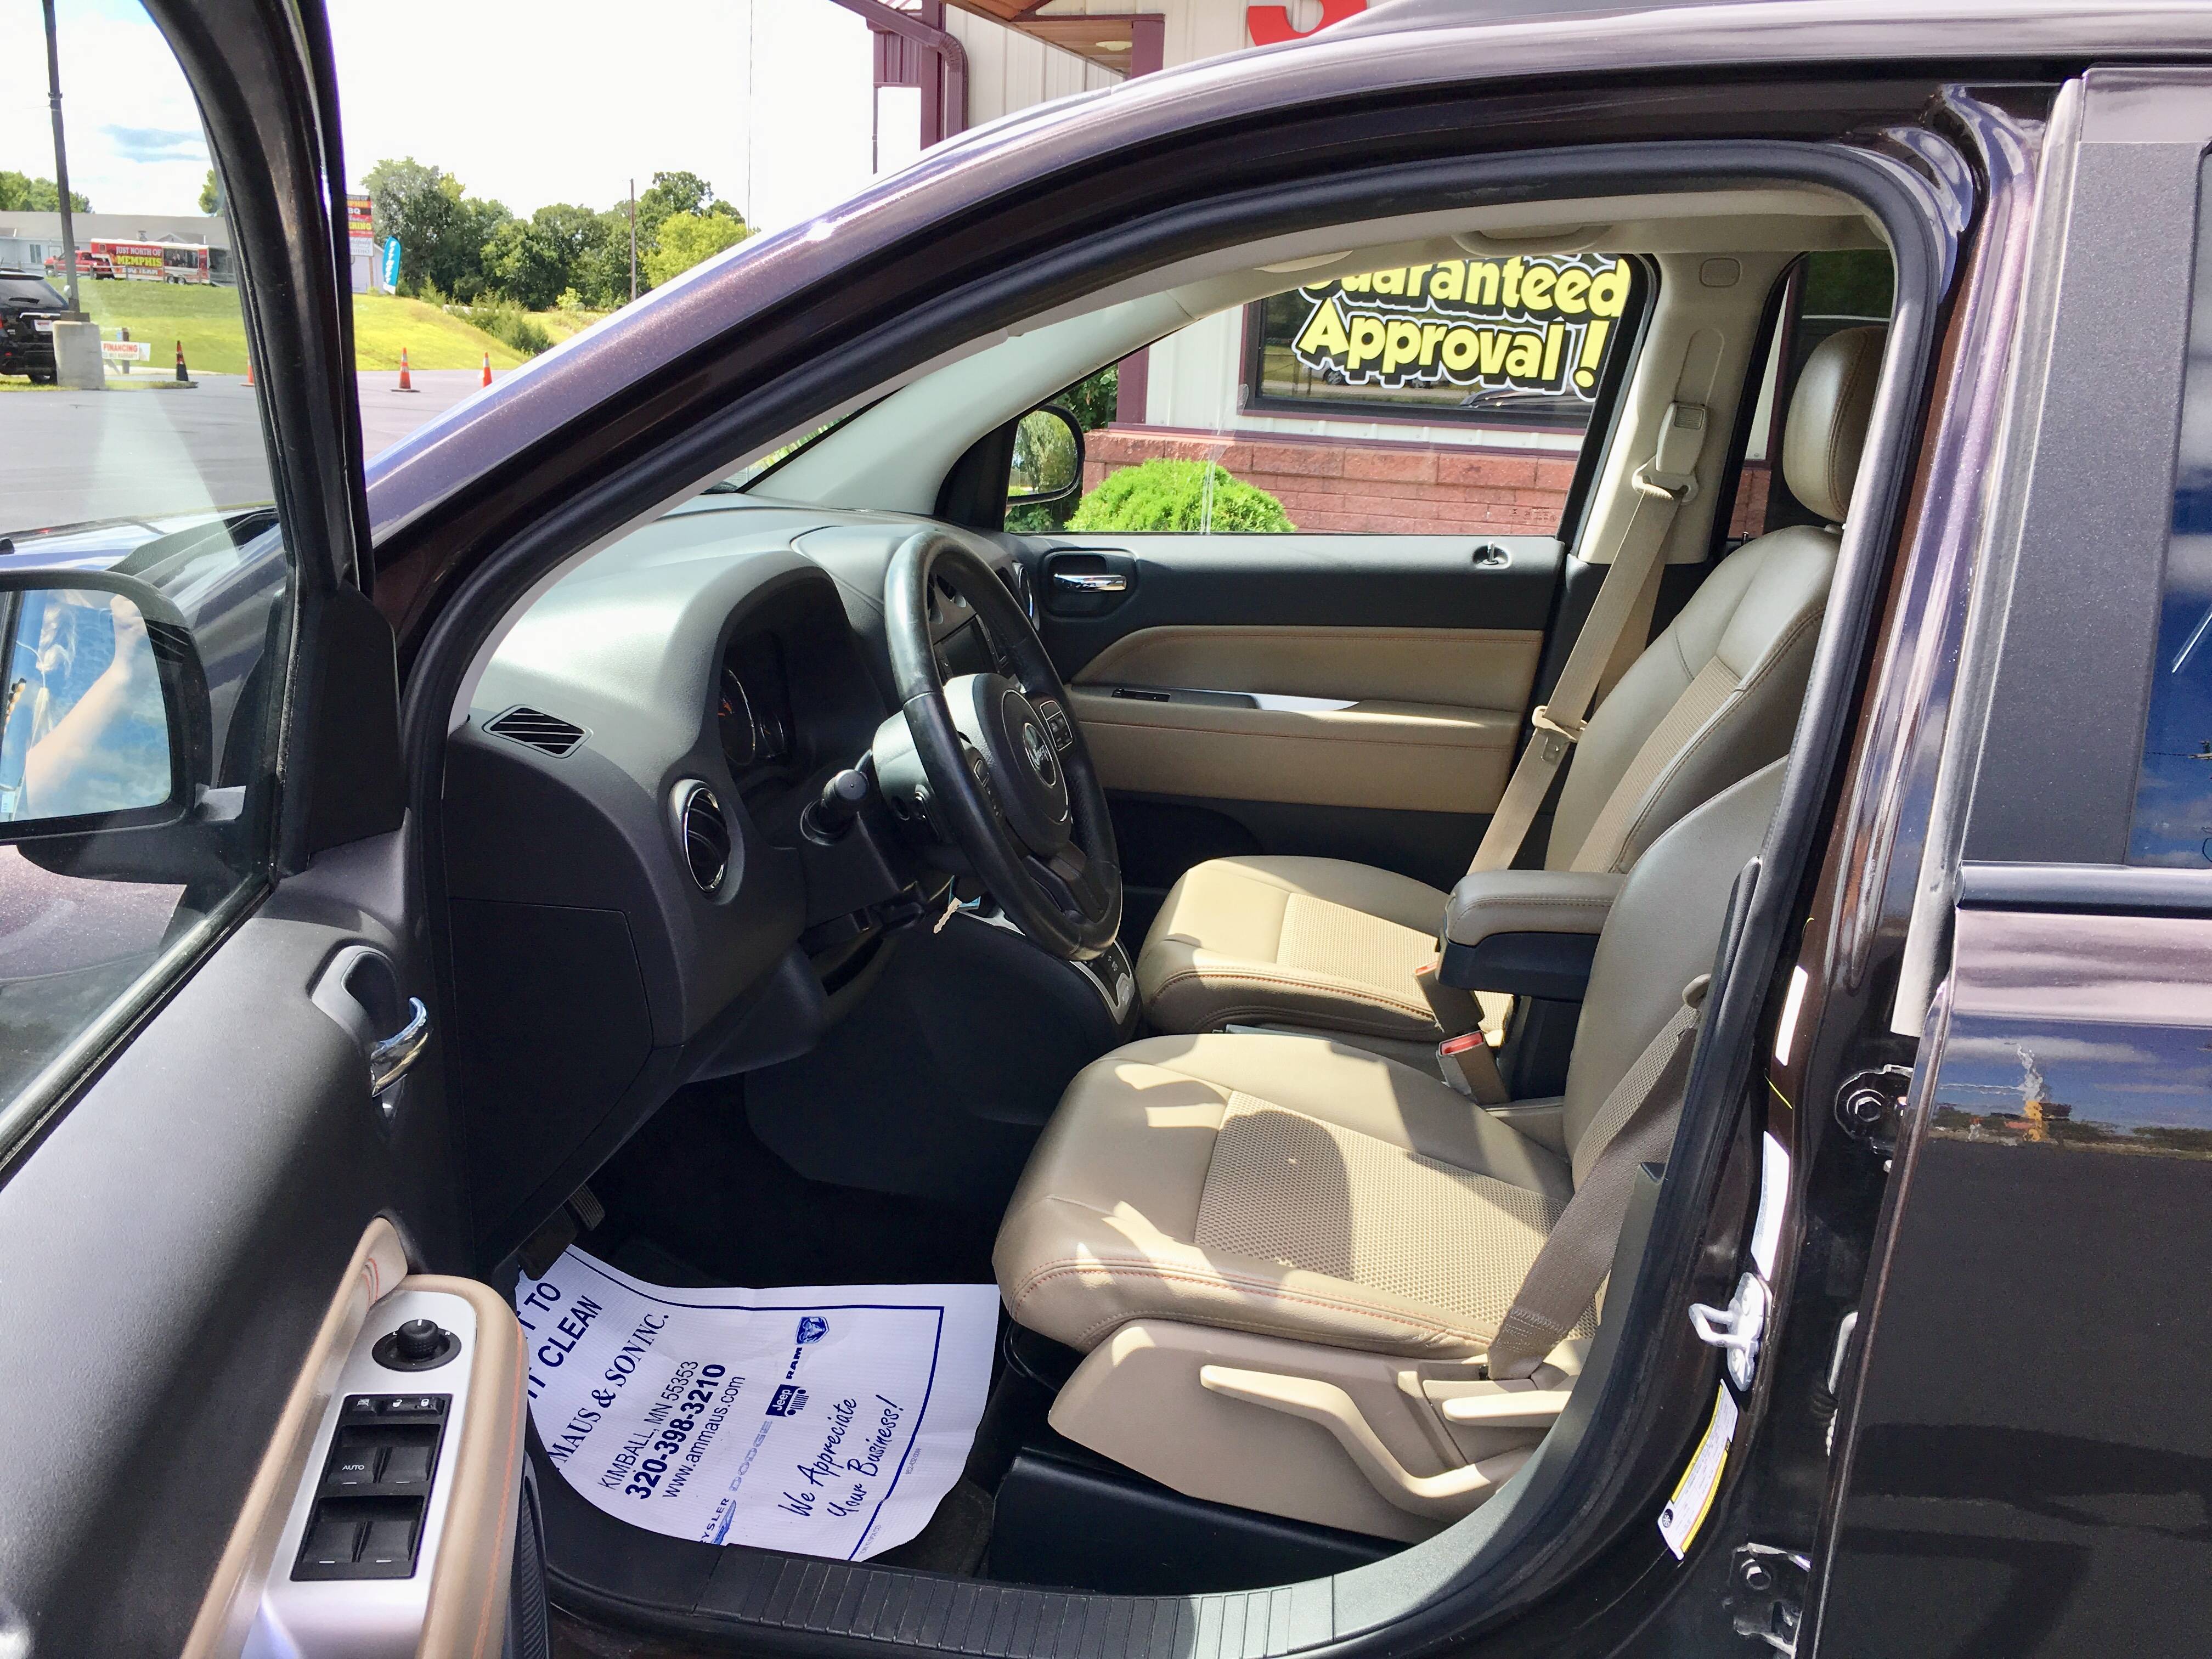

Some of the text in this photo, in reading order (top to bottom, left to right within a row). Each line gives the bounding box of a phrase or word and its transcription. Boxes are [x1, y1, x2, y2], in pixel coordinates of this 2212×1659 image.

[116, 246, 129, 255] JUST
[130, 247, 151, 256] NORTH
[117, 255, 162, 267] MEMPHIS
[103, 343, 138, 352] FINANCING
[523, 1282, 561, 1312] TO
[538, 1295, 602, 1367] CLEAN
[591, 1387, 616, 1408] &
[597, 1361, 698, 1491] KIMBALL, MN 55353
[625, 1364, 726, 1500] 320-398-3210
[662, 1376, 746, 1498] www.ammaus.com
[729, 1421, 773, 1492] DODGE
[772, 1389, 793, 1411] Jeep
[786, 1347, 803, 1380] RAM
[777, 1398, 857, 1517] We Appreciate
[827, 1483, 867, 1517] Your
[847, 1394, 904, 1477] Business!
